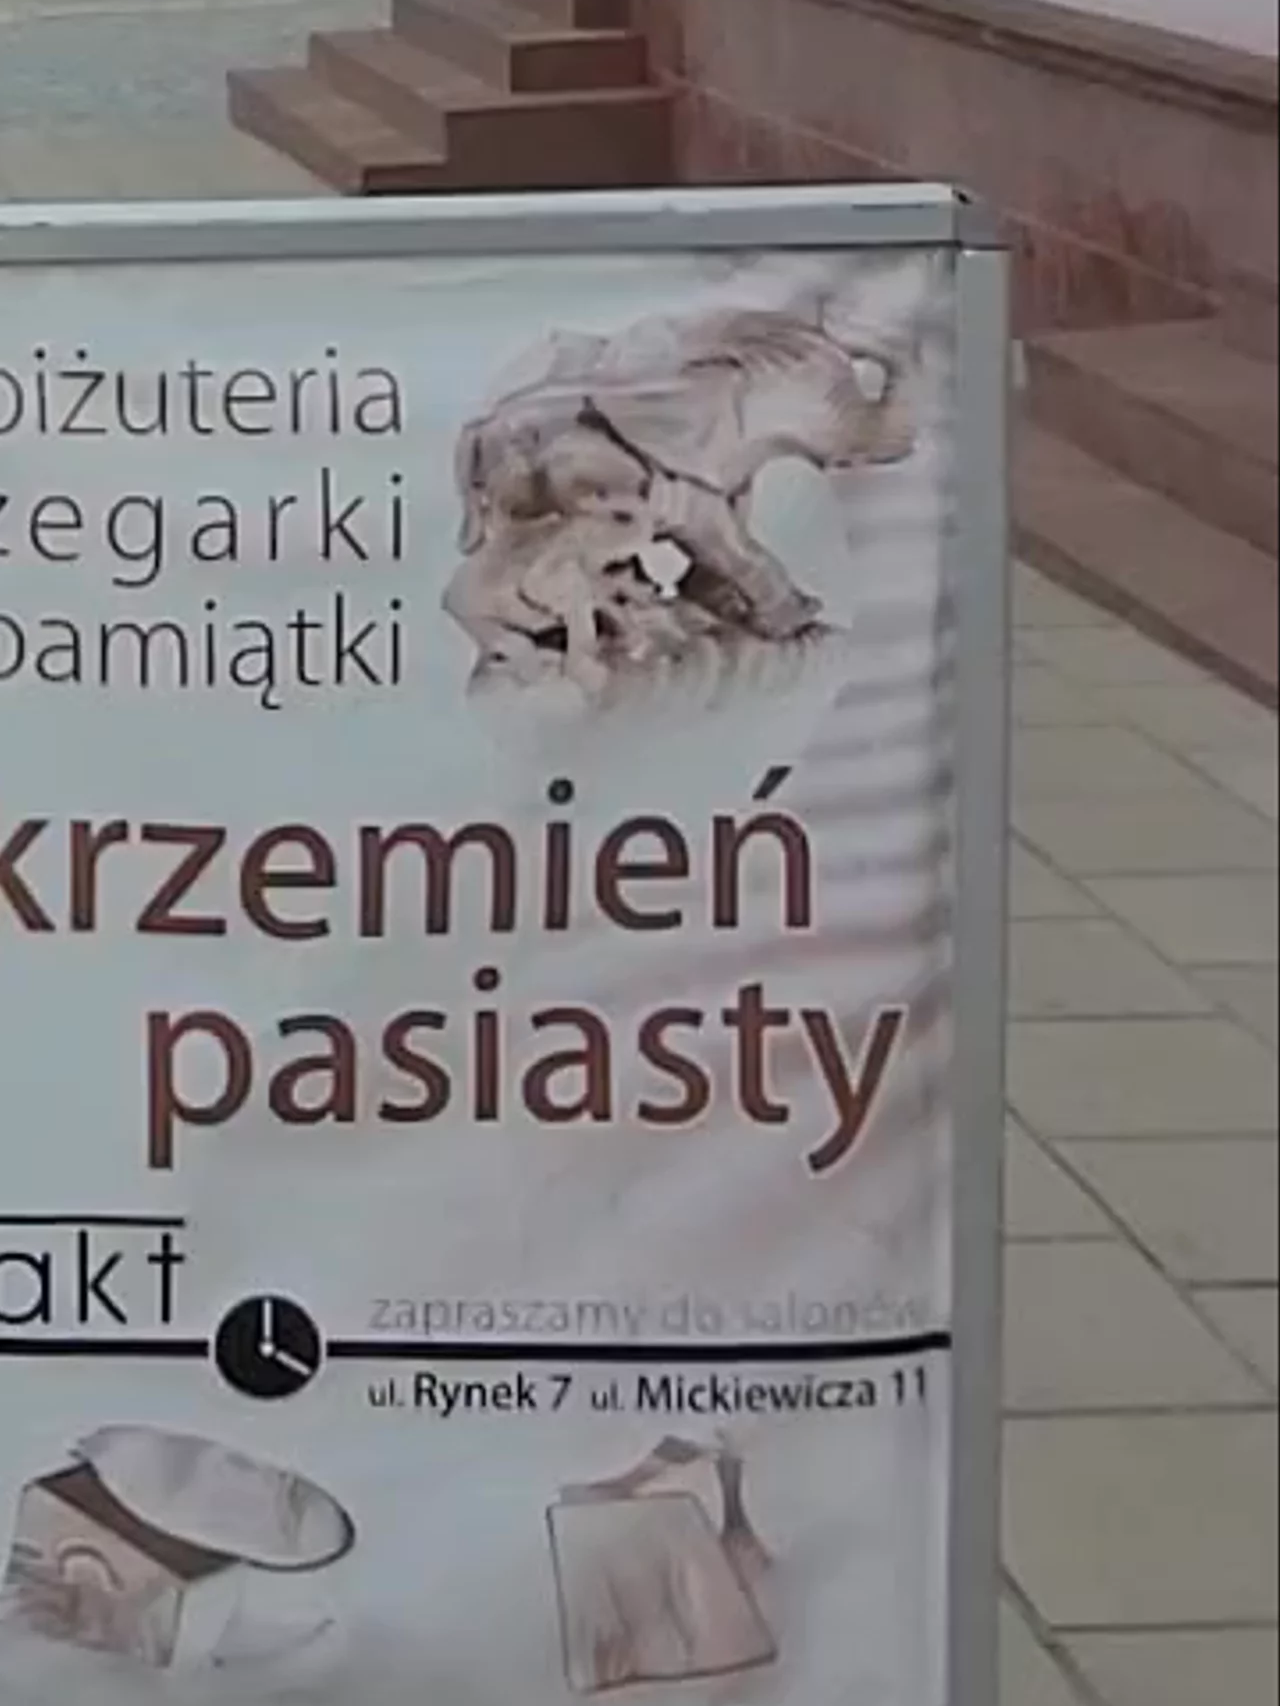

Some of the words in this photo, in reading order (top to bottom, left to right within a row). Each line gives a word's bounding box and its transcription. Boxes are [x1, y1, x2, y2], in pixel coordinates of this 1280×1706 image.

[145, 965, 904, 1174] pasiasty
[368, 1297, 647, 1337] zapraszamy
[661, 1292, 723, 1335] do
[367, 1376, 405, 1408] ul.
[413, 1370, 538, 1418] Rynek
[548, 1373, 572, 1411] 7
[591, 1379, 625, 1411] ul.
[637, 1372, 877, 1414] Mickiewicza
[891, 1366, 926, 1406] 11
